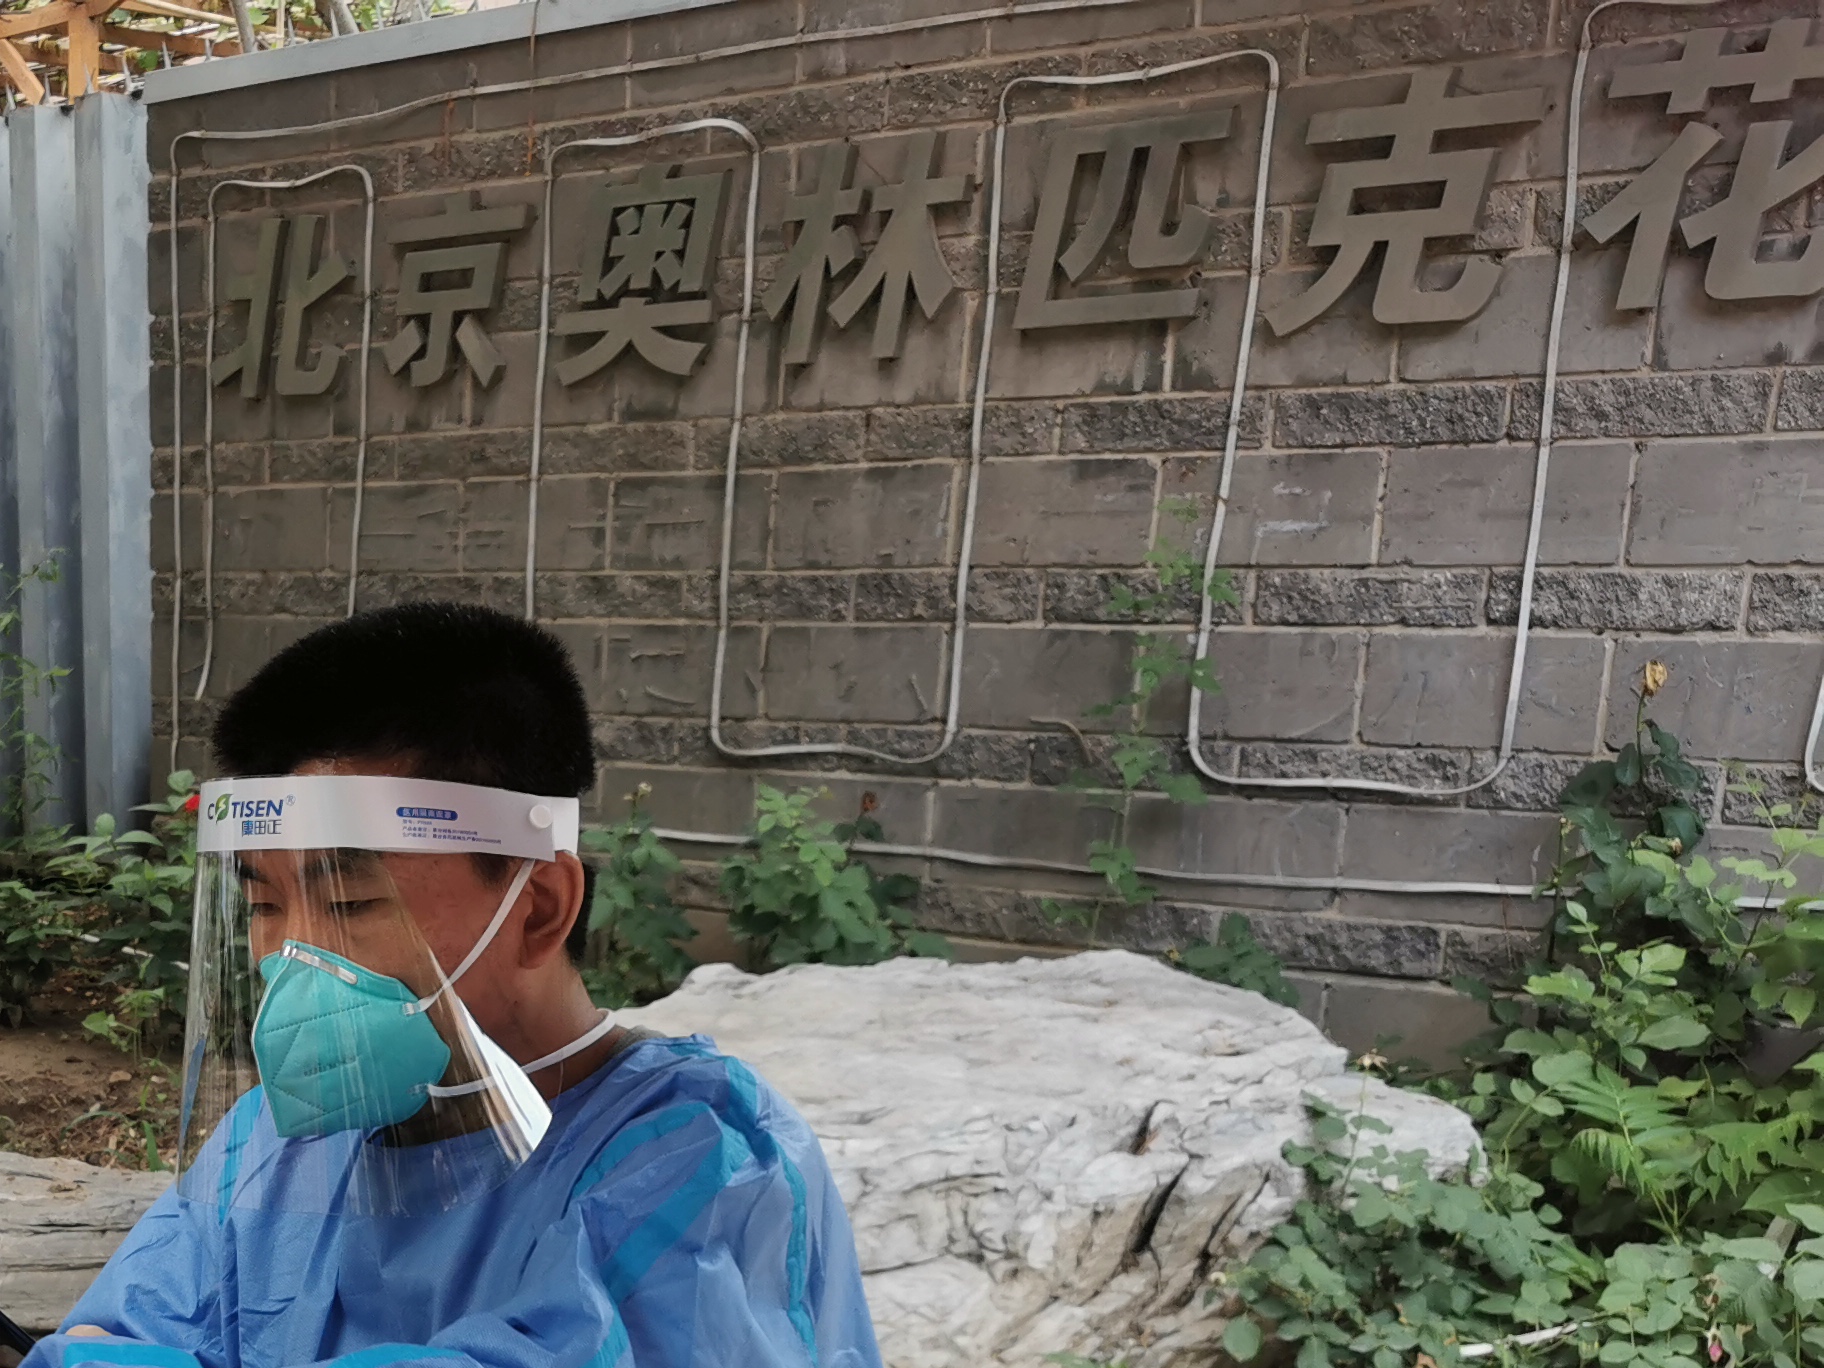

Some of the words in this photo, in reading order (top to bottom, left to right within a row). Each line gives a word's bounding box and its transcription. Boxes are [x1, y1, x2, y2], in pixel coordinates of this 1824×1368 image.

[211, 17, 1824, 401] 北京奥林匹克花
